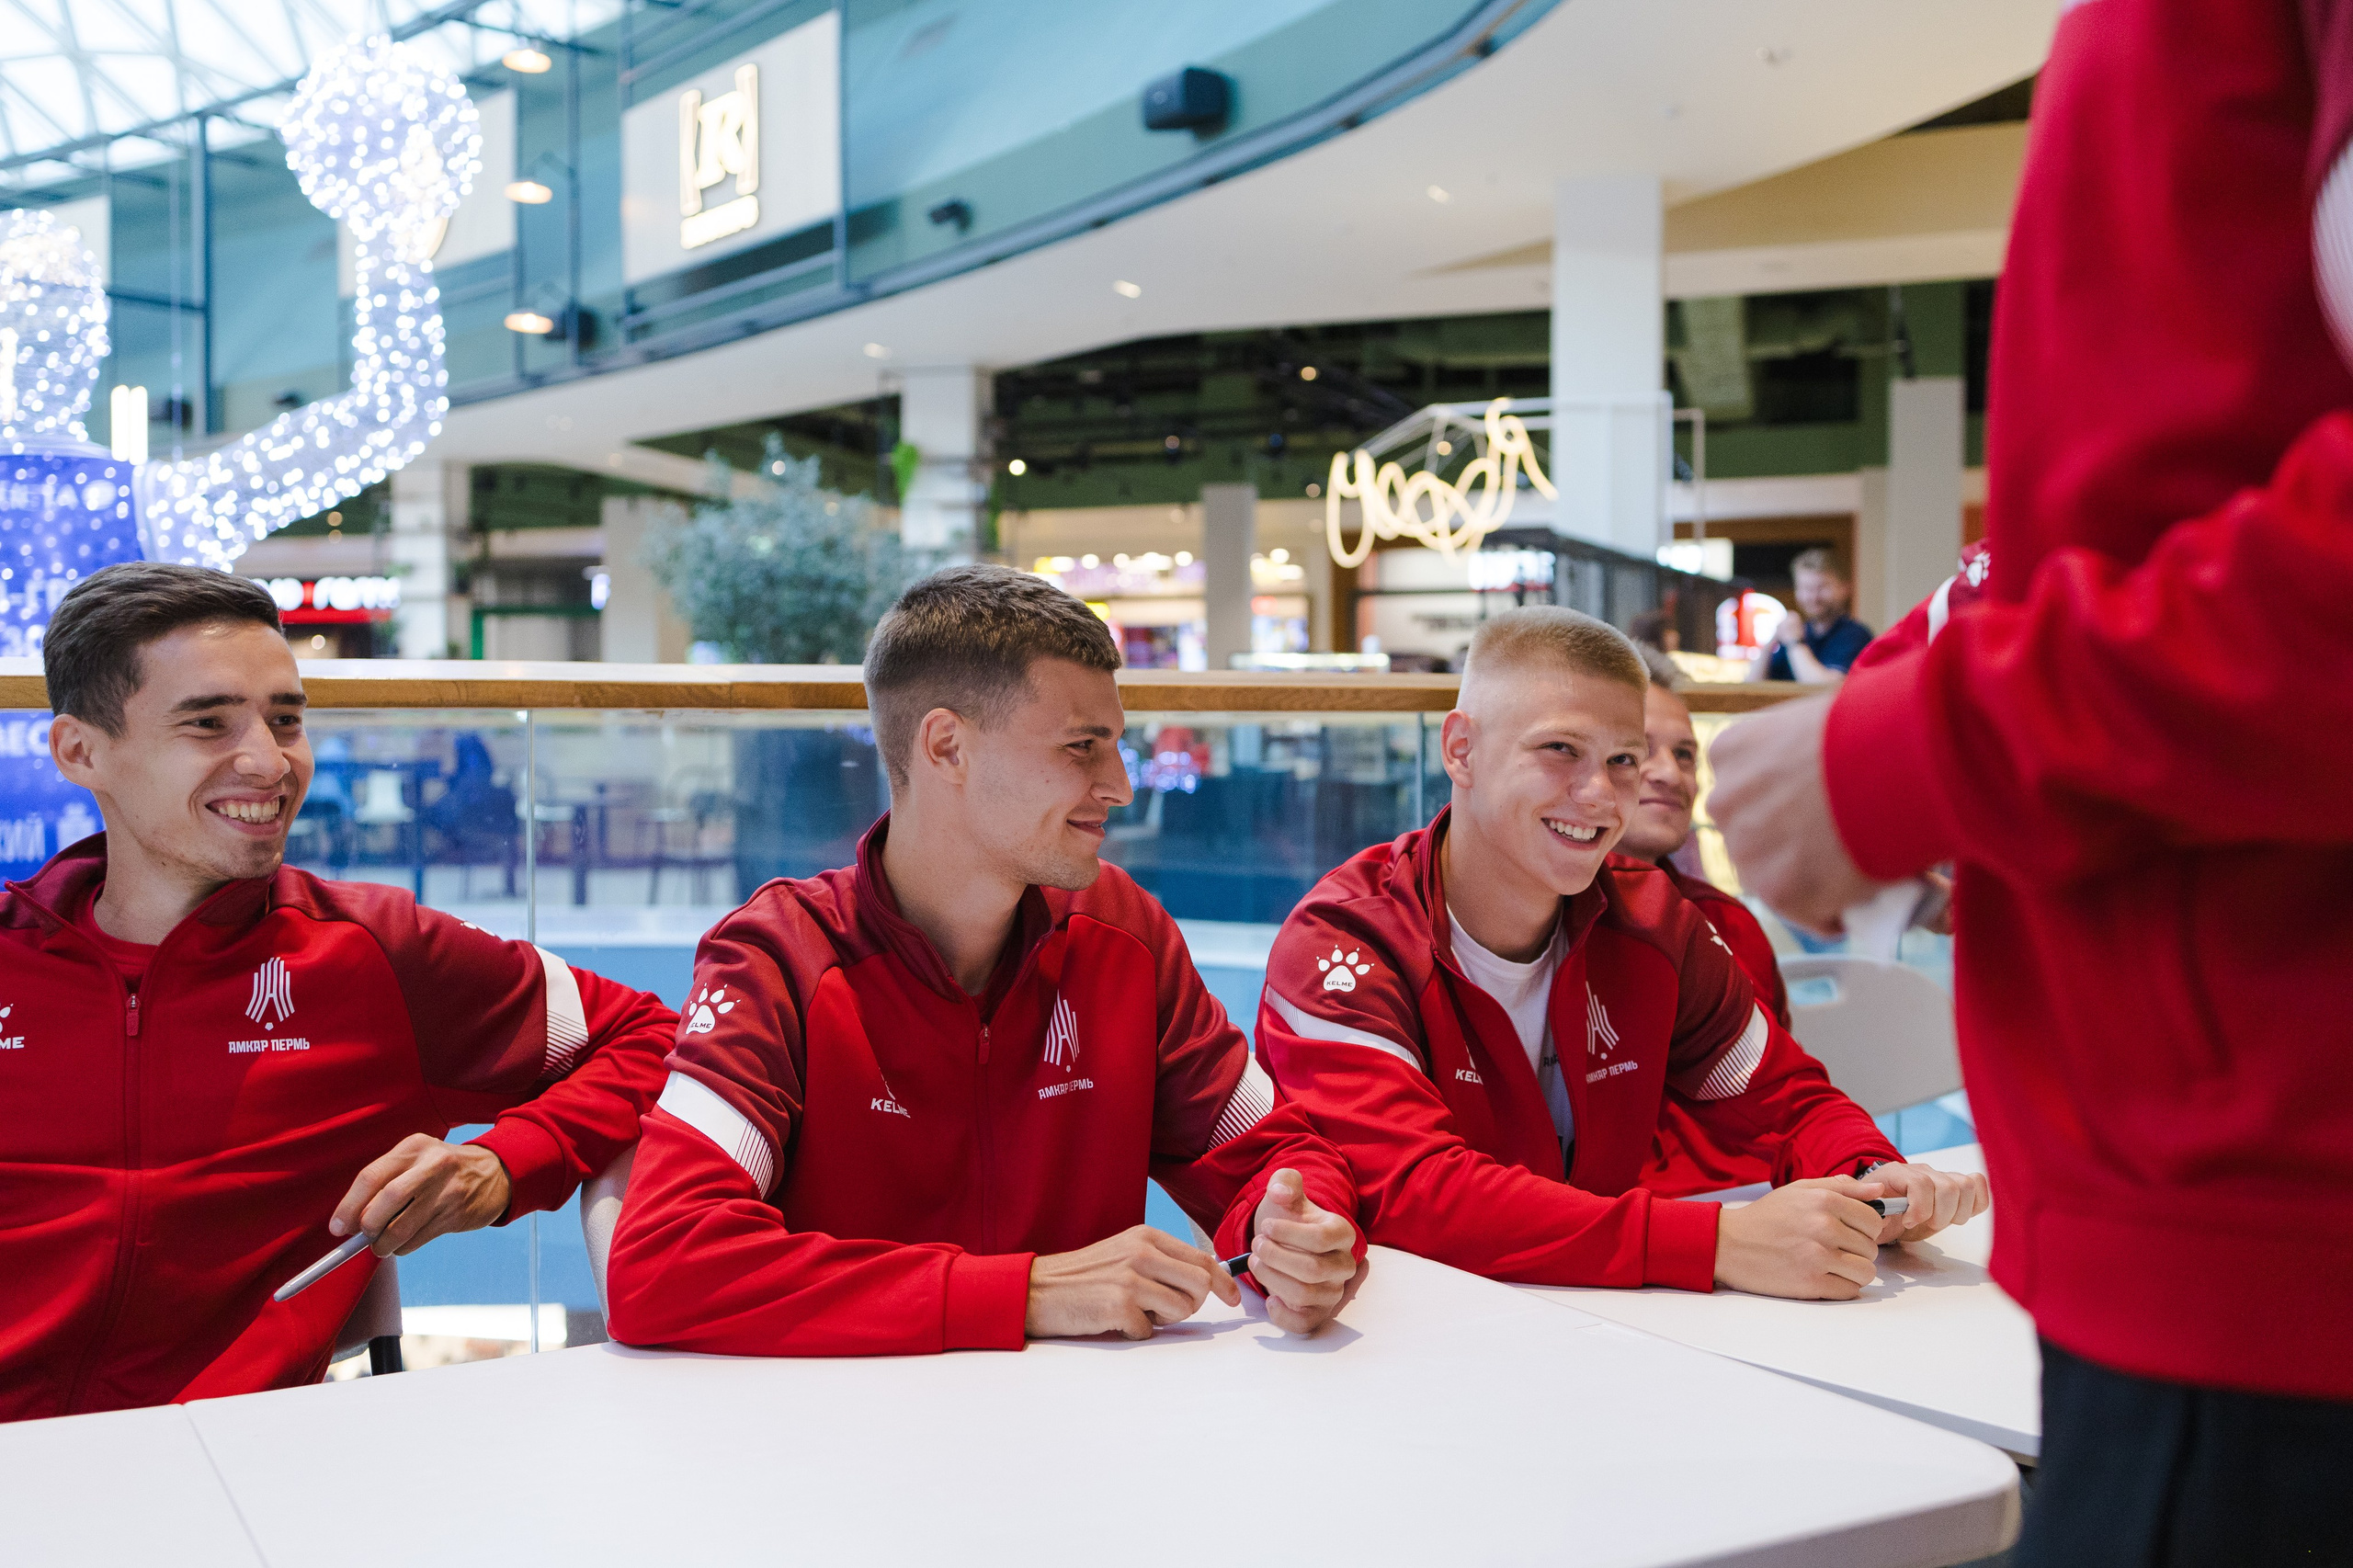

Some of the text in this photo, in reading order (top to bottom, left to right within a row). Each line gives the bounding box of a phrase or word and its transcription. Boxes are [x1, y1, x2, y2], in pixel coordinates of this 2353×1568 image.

[1326, 980, 1353, 988] KELME
[228, 1038, 311, 1053] АМКАР ПЕРМЬ
[1608, 1061, 1638, 1076] ПЕРМЬ
[1038, 1083, 1068, 1100] АМКАР
